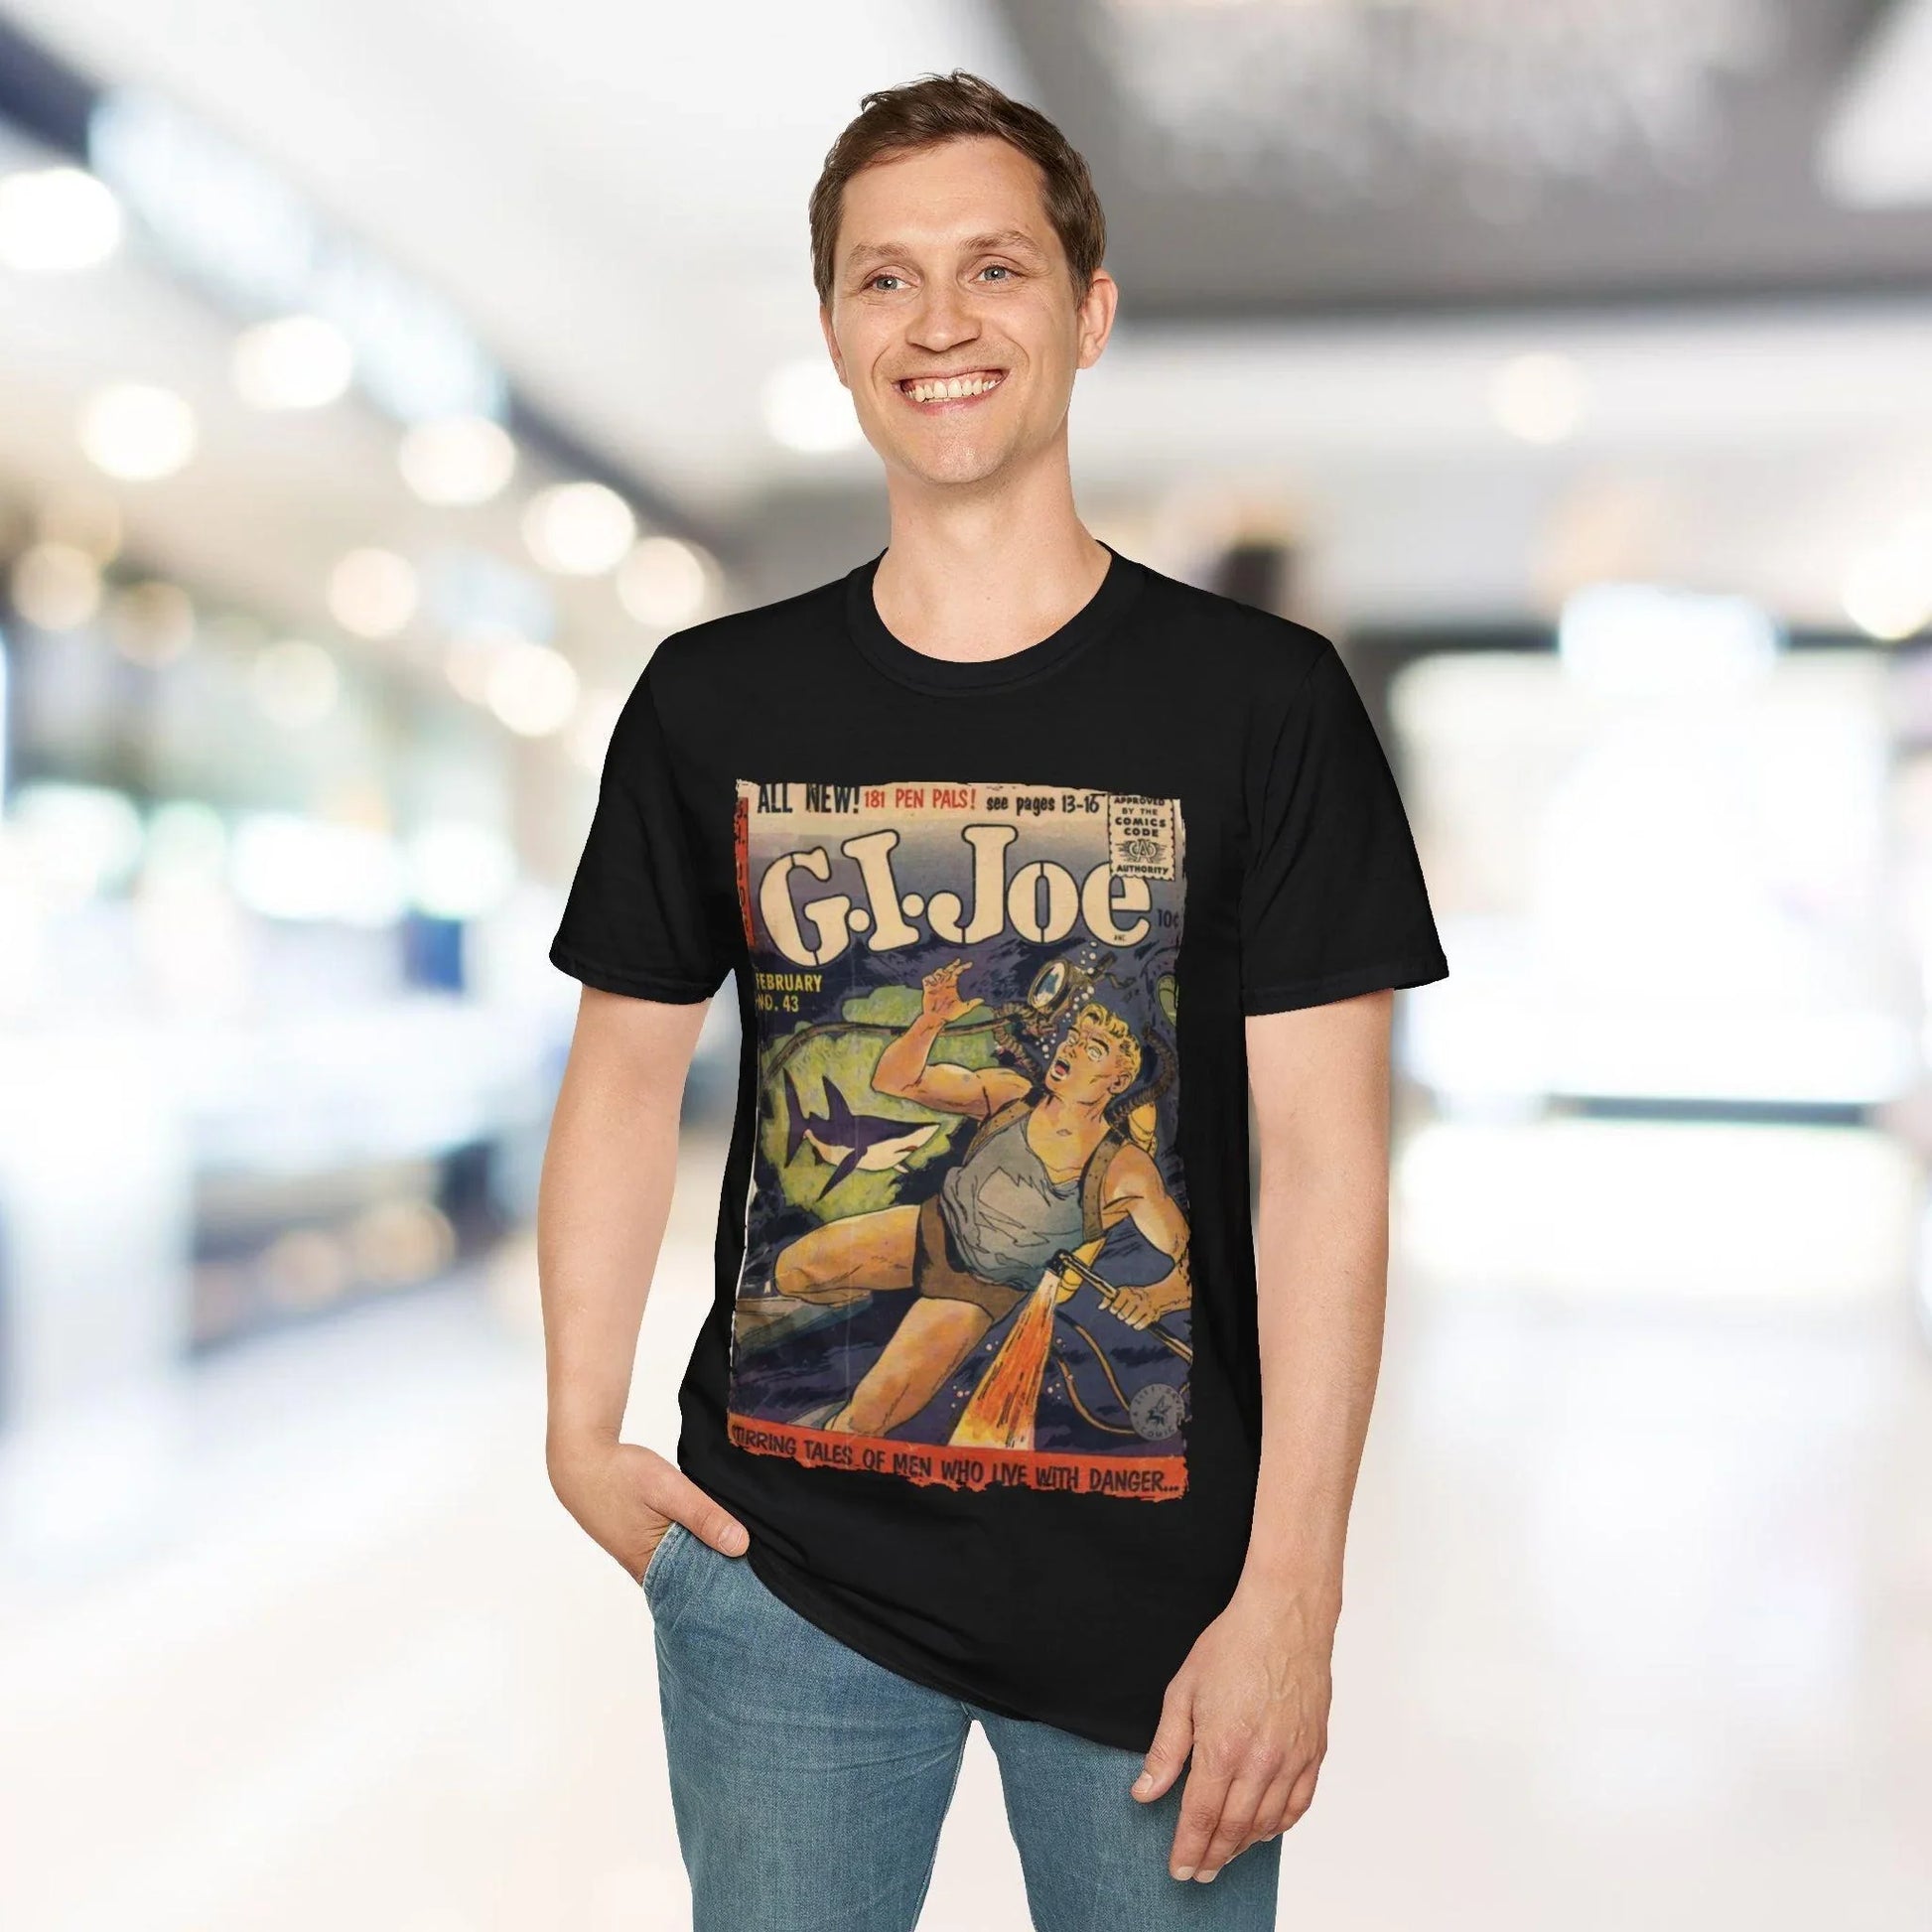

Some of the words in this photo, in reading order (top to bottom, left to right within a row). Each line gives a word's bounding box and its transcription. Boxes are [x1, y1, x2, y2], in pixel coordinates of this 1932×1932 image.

[758, 783, 792, 813] ALL
[806, 783, 860, 814] NEW!
[865, 790, 885, 808] 181
[896, 788, 924, 809] PEN
[932, 788, 976, 809] PALS!
[986, 795, 1009, 810] see
[1016, 795, 1055, 816] pages
[1114, 796, 1166, 806] APPROVED
[1115, 817, 1167, 828] COMICS
[1124, 827, 1159, 837] CODE
[1117, 865, 1169, 875] AUTHORITY
[756, 973, 822, 993] FEBRUARY
[756, 994, 778, 1012] NO.
[782, 995, 799, 1013] 43
[803, 1439, 853, 1466] TALES
[862, 1448, 887, 1471] OF
[894, 1452, 931, 1477] MEN
[941, 1459, 984, 1483] WHO
[1035, 1465, 1079, 1490] WITH
